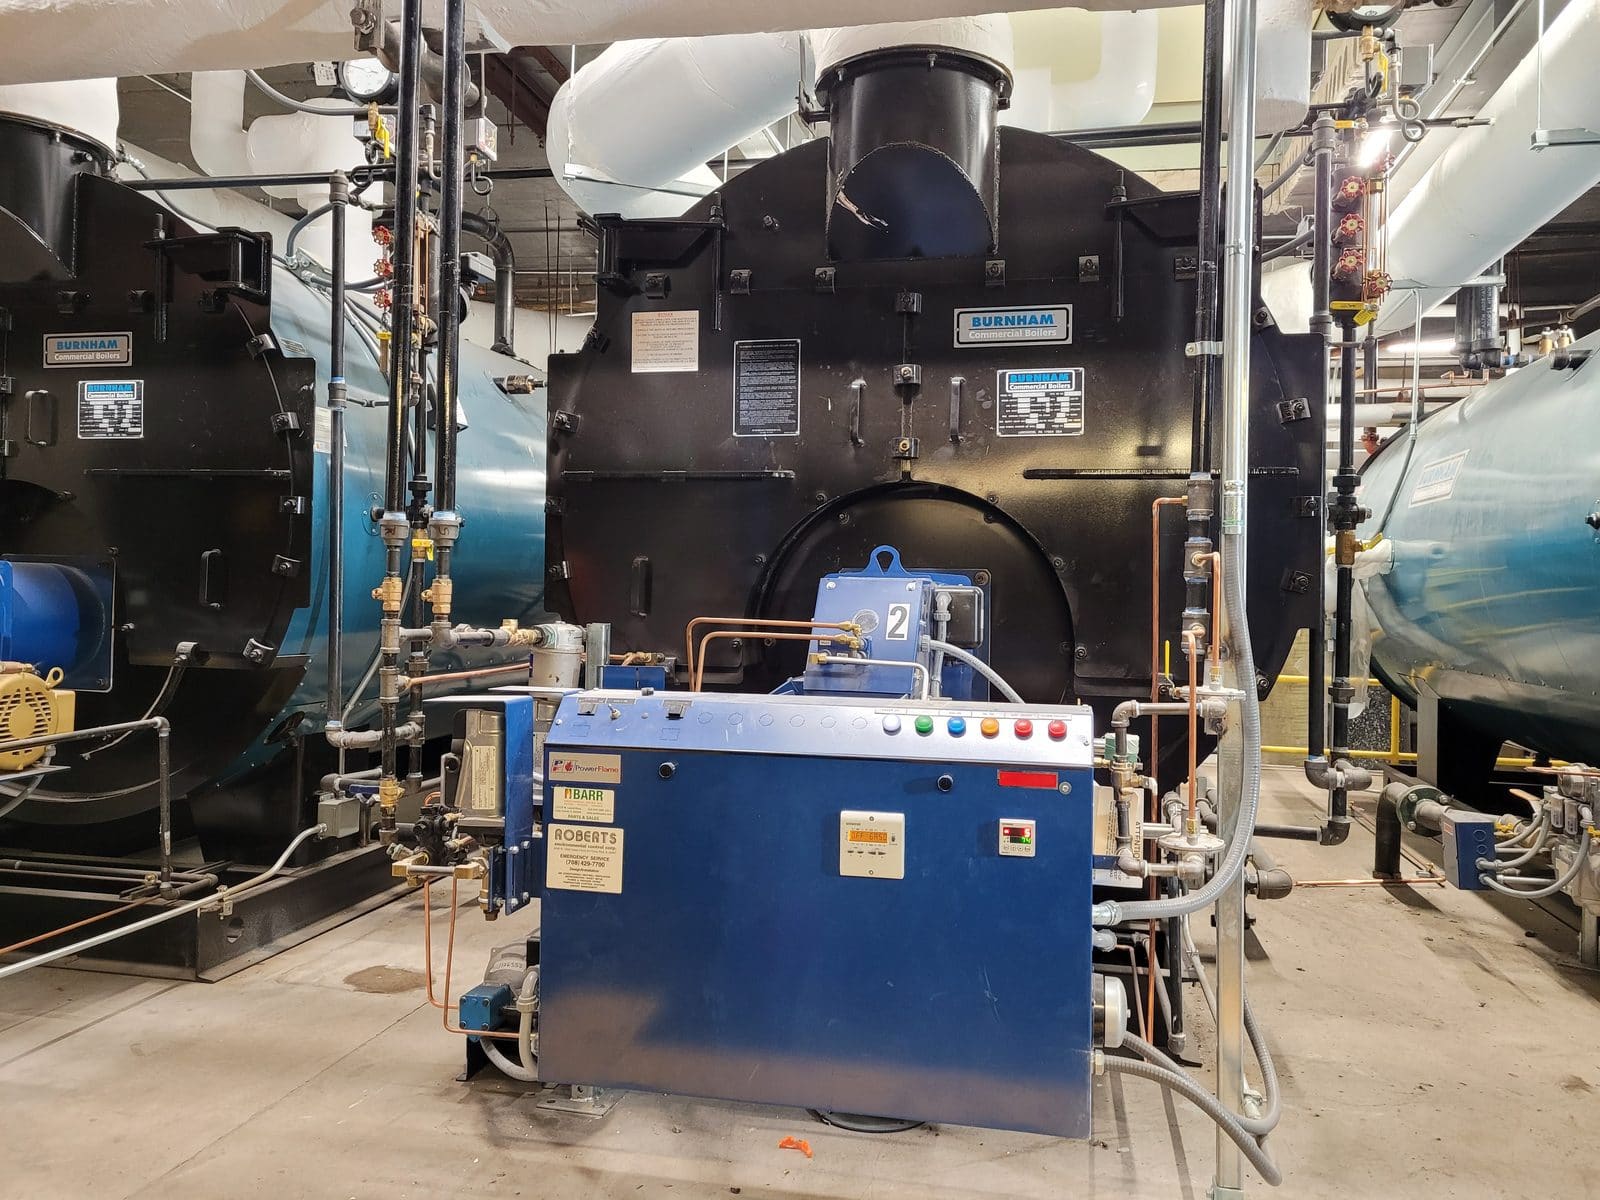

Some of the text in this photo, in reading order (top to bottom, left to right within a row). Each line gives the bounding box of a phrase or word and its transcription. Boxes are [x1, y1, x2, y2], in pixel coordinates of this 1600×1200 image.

[971, 314, 1054, 327] BURNHAM
[969, 329, 1057, 339] Commercial Boilers
[57, 340, 118, 350] BURNHAM
[54, 352, 120, 361] Commercial Boilers
[1009, 373, 1069, 382] BURNHAM
[88, 384, 132, 392] BURNHAM
[888, 605, 908, 638] 2
[575, 764, 619, 773] PowerFlame
[573, 789, 603, 801] BARR
[554, 828, 617, 845] ROBERTS
